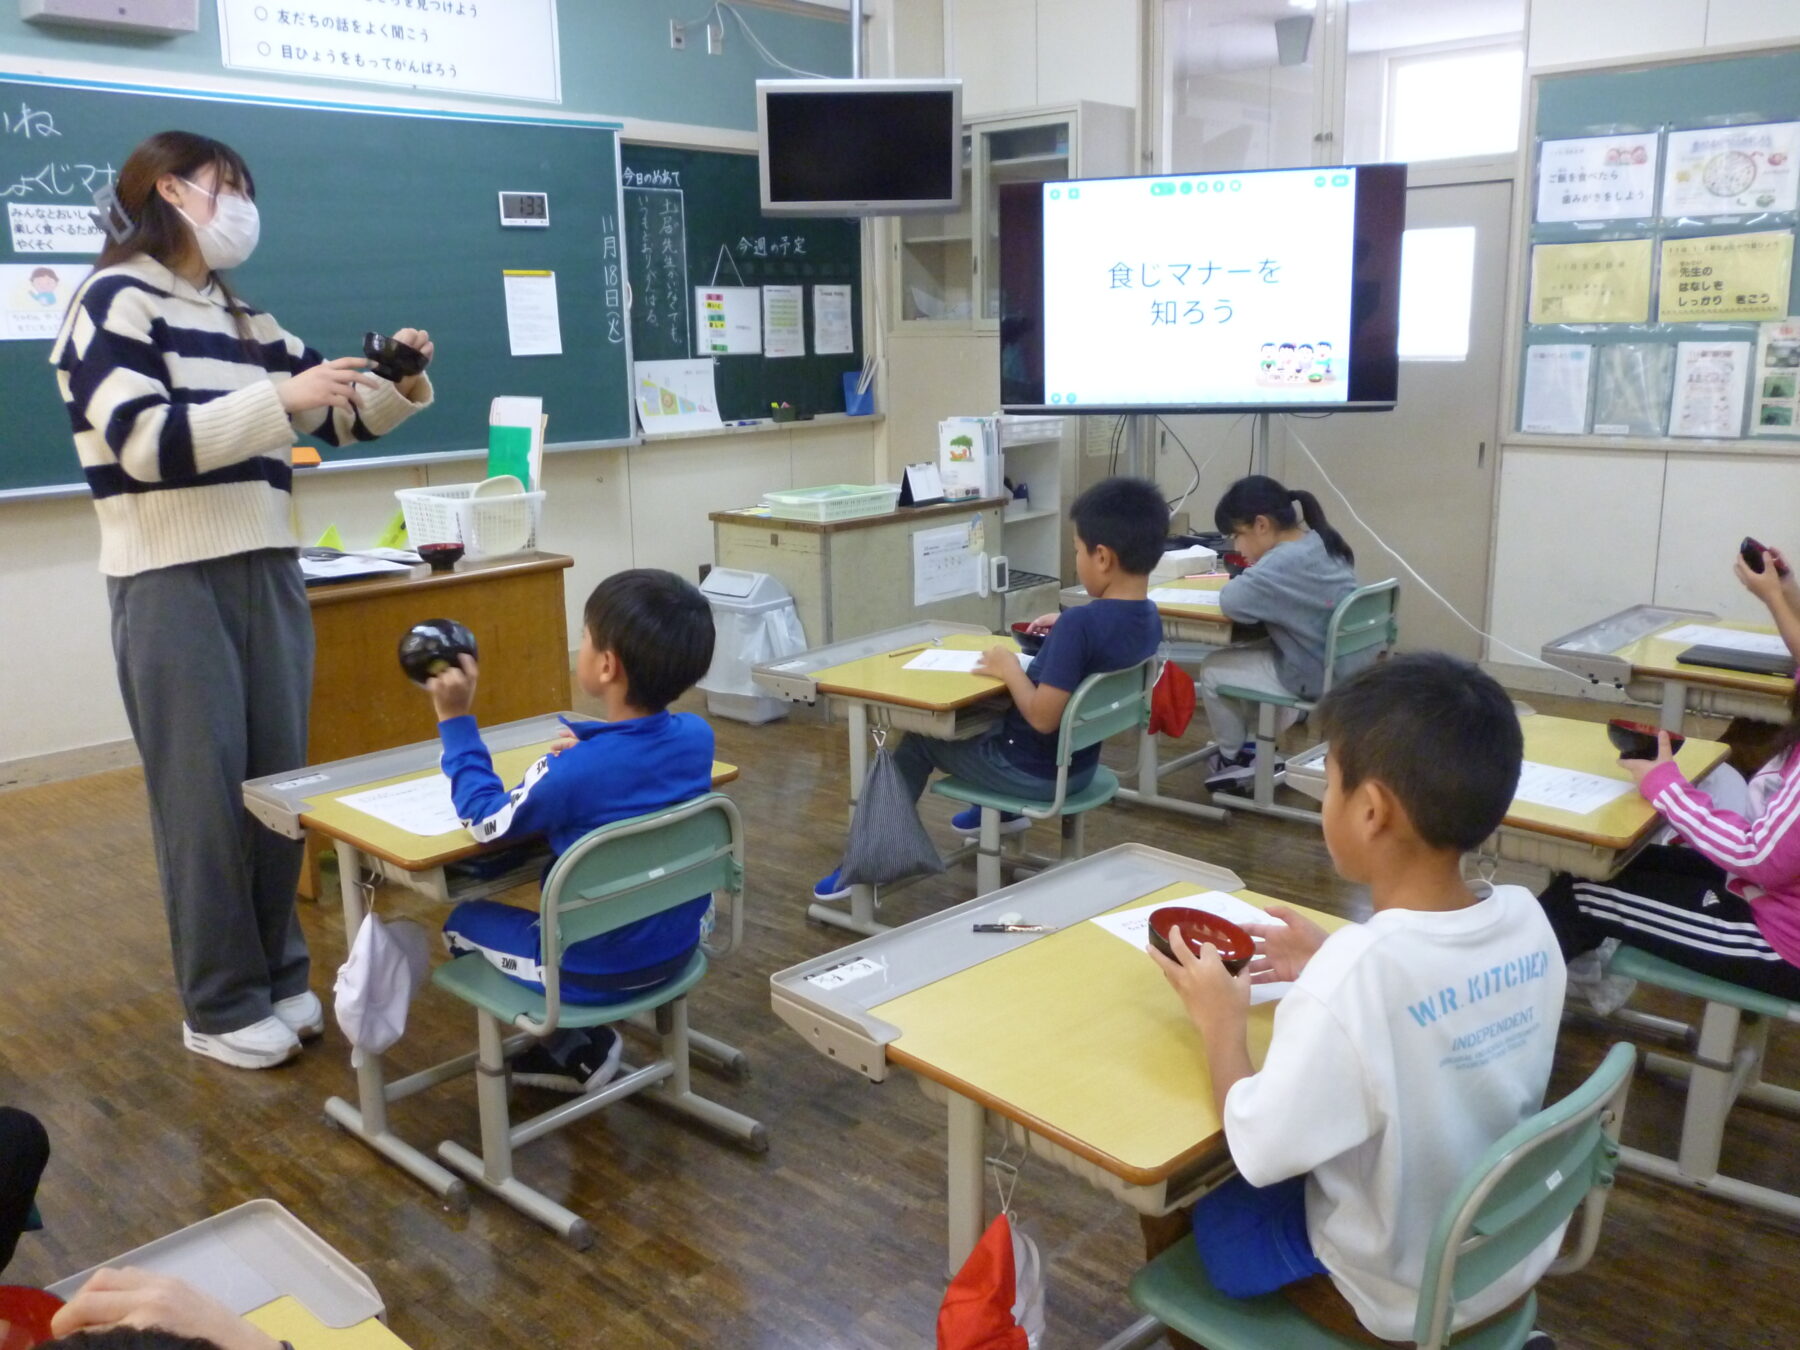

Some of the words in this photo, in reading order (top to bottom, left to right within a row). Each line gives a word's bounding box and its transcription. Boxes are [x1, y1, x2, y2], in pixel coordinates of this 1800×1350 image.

[277, 9, 429, 43] 友だちの話をよく聞こう
[281, 44, 457, 78] 目ひょうをもってがんばろう
[622, 166, 681, 187] 今日のめあて
[11, 207, 93, 221] みんなとおいし
[16, 238, 54, 250] やくそく
[736, 235, 807, 257] 今週の予定
[1108, 258, 1283, 290] 食じマナーを
[1679, 266, 1713, 278] 先生の
[1678, 280, 1724, 292] はなしを
[1678, 295, 1722, 307] しっかり
[1736, 293, 1770, 305] きこう
[1150, 299, 1235, 327] 知ろう
[501, 957, 518, 971] NIKE
[1467, 950, 1549, 1004] KITCHEN
[1452, 1006, 1534, 1051] INDEPENDENT
